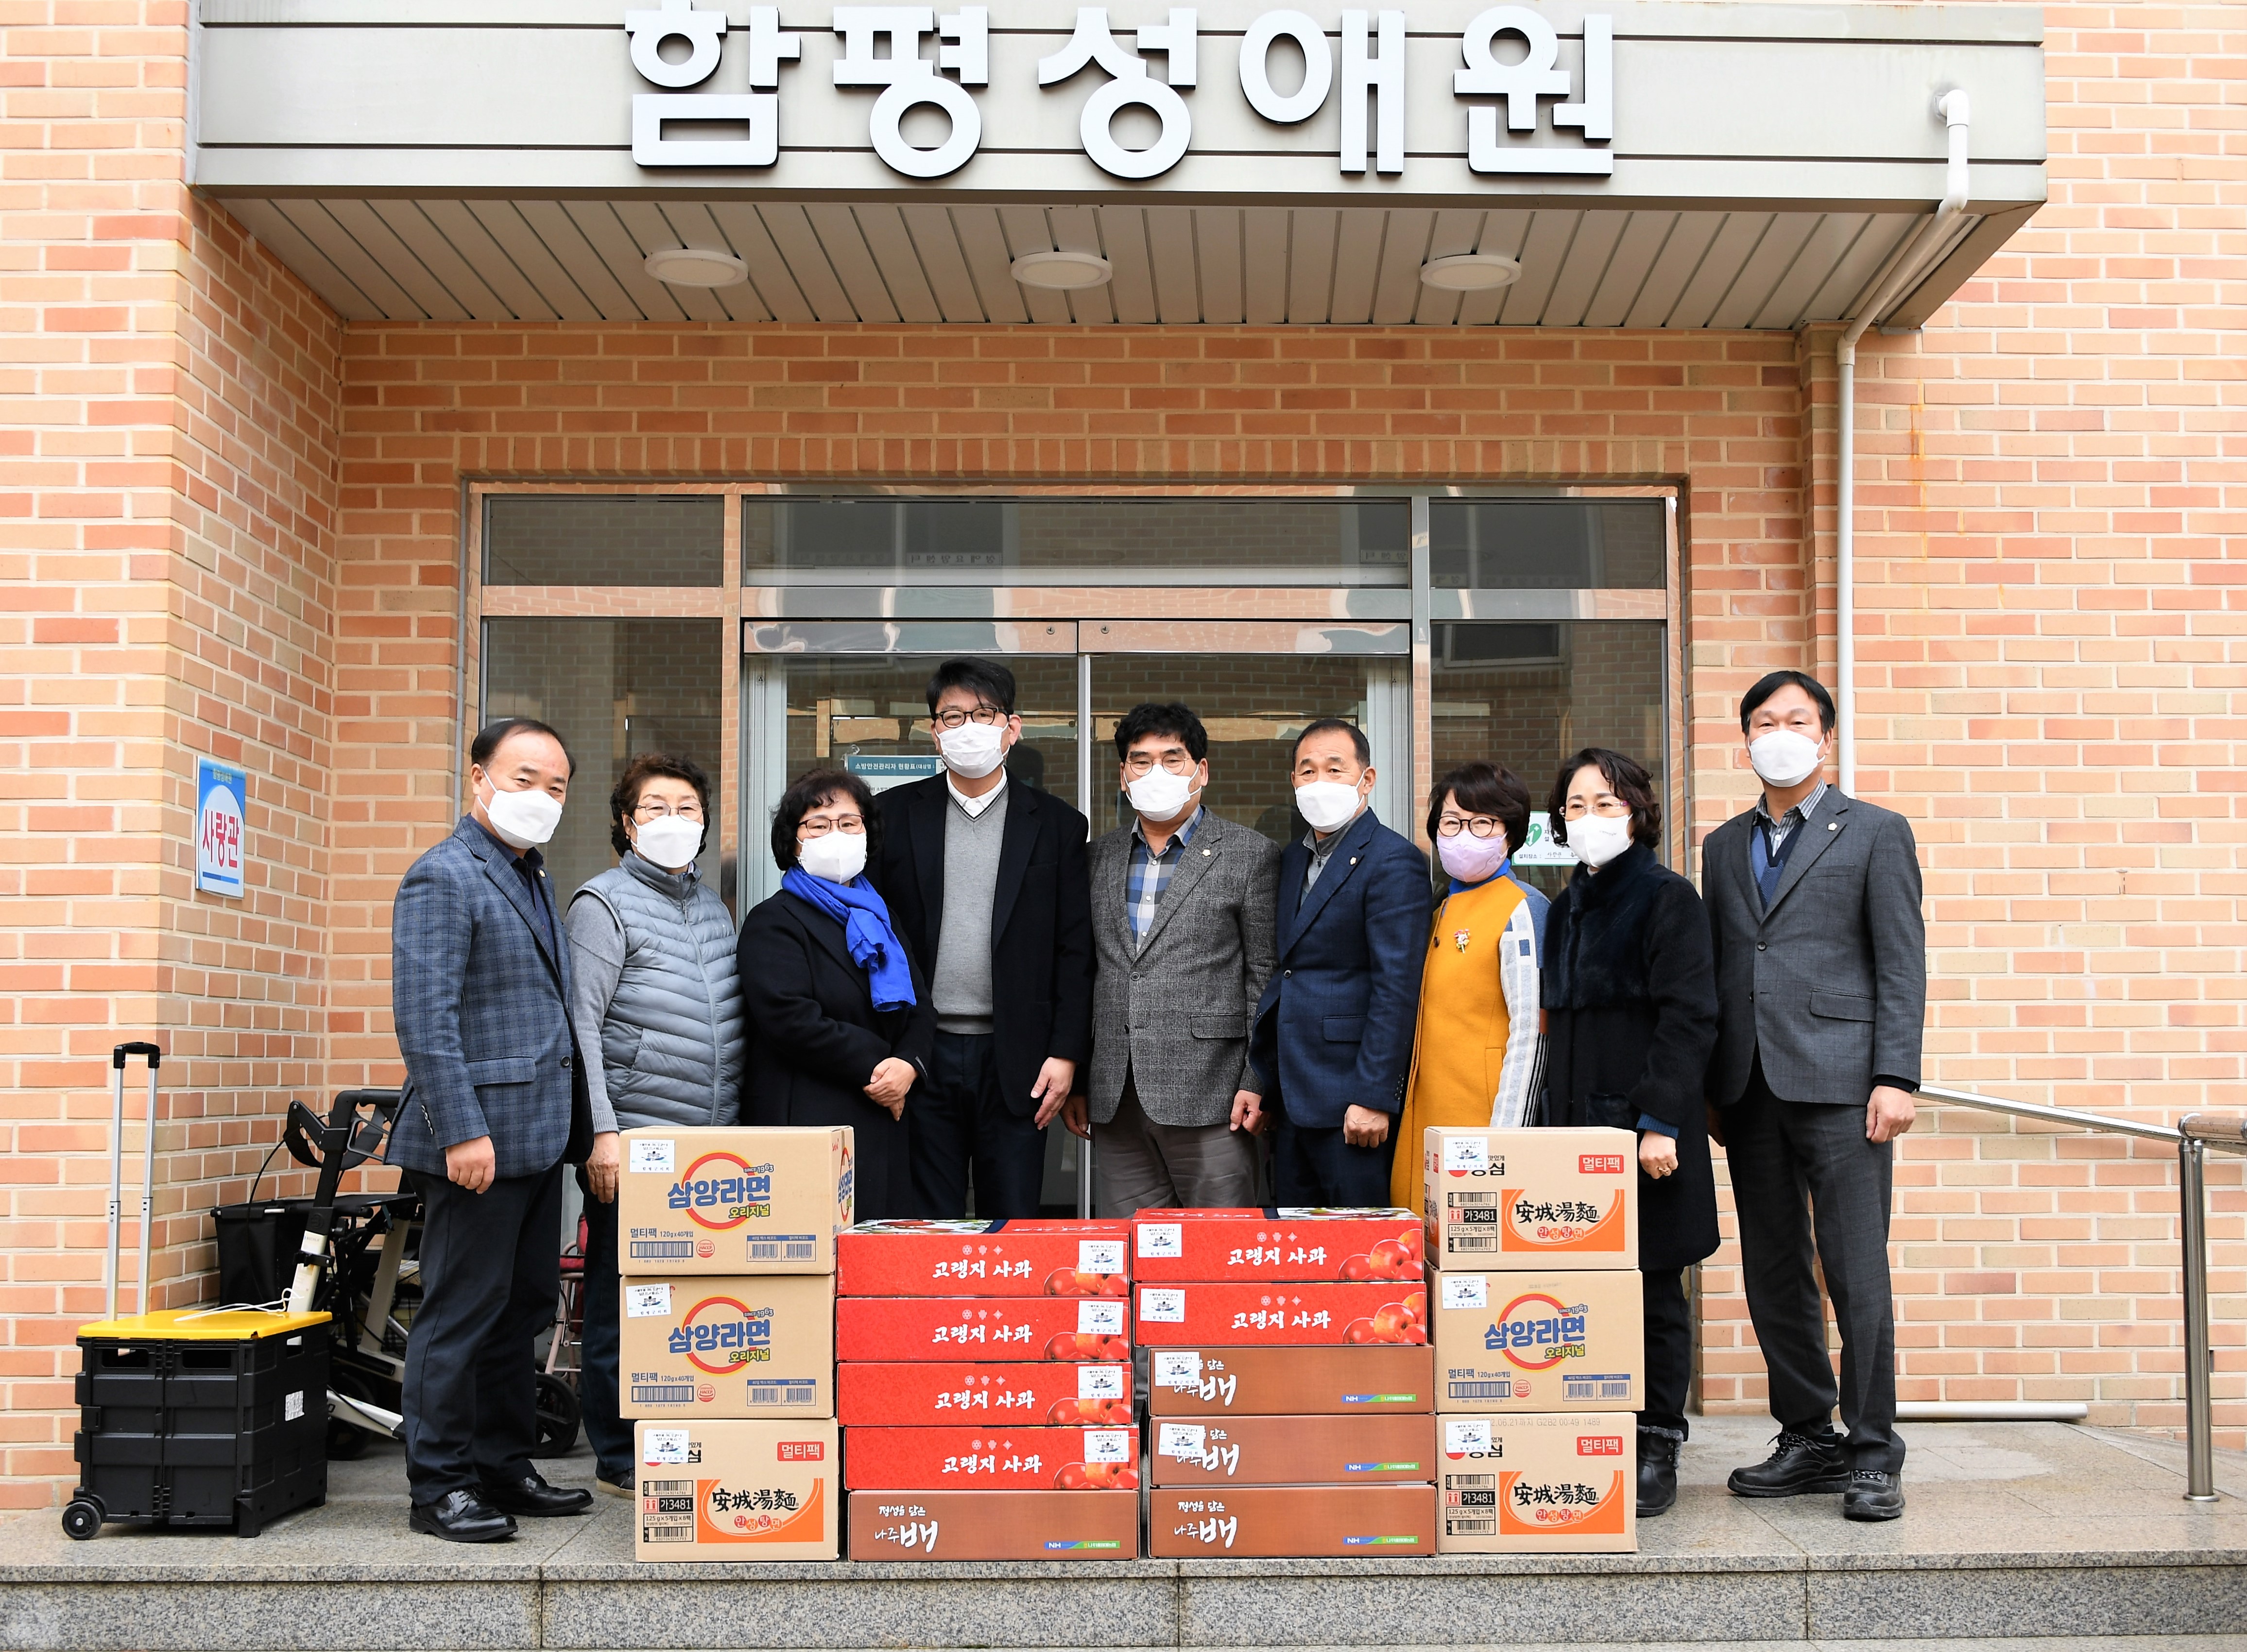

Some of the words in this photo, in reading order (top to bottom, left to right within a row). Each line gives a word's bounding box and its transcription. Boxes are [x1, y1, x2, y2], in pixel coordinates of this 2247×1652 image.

[625, 0, 1613, 179] 함평성애원
[203, 809, 239, 868] 사랑관
[757, 1164, 773, 1173] 1963
[1582, 1157, 1620, 1171] 멀티팩
[668, 1175, 771, 1209] 삼양라면
[729, 1204, 771, 1219] 오리지널
[1465, 1210, 1495, 1222] 가3481
[631, 1228, 657, 1238] 멀티팩
[1538, 1226, 1584, 1240] 안성탕면
[1227, 1246, 1281, 1266] 고랭지
[1287, 1246, 1327, 1266] 사과
[932, 1259, 986, 1279] 고랭지
[993, 1259, 1033, 1279] 사과
[757, 1308, 773, 1318] 1963
[1571, 1304, 1588, 1314] 1963
[1231, 1310, 1285, 1330] 고랭지
[1291, 1310, 1332, 1329] 사과
[668, 1319, 771, 1353] 삼양라면
[931, 1324, 986, 1344] 고랭지
[993, 1324, 1033, 1344] 사과
[1484, 1315, 1585, 1350] 삼양라면
[729, 1348, 771, 1363] 오리지널
[1544, 1344, 1585, 1359] 오리지널
[1207, 1359, 1224, 1370] 담은
[632, 1372, 658, 1382] 멀티팩
[1448, 1368, 1475, 1379] 멀티팩
[934, 1389, 989, 1410] 고랭지
[995, 1390, 1036, 1409] 사과
[1560, 1418, 1579, 1426] 00:49
[1584, 1418, 1600, 1426] 1489
[1210, 1428, 1227, 1440] 담은
[781, 1444, 820, 1459] 멀티팩
[1580, 1438, 1619, 1453] 멀티팩
[941, 1454, 995, 1474] 고랭지
[1002, 1454, 1043, 1474] 사과
[661, 1499, 691, 1511] 가3481
[1463, 1493, 1493, 1504] 가3481
[878, 1504, 905, 1516] 정성을
[908, 1504, 926, 1516] 담은
[1178, 1500, 1204, 1512] 정성을
[1207, 1500, 1225, 1512] 담은
[1537, 1509, 1582, 1522] 안성탕면
[734, 1516, 781, 1531] 안성탕면
